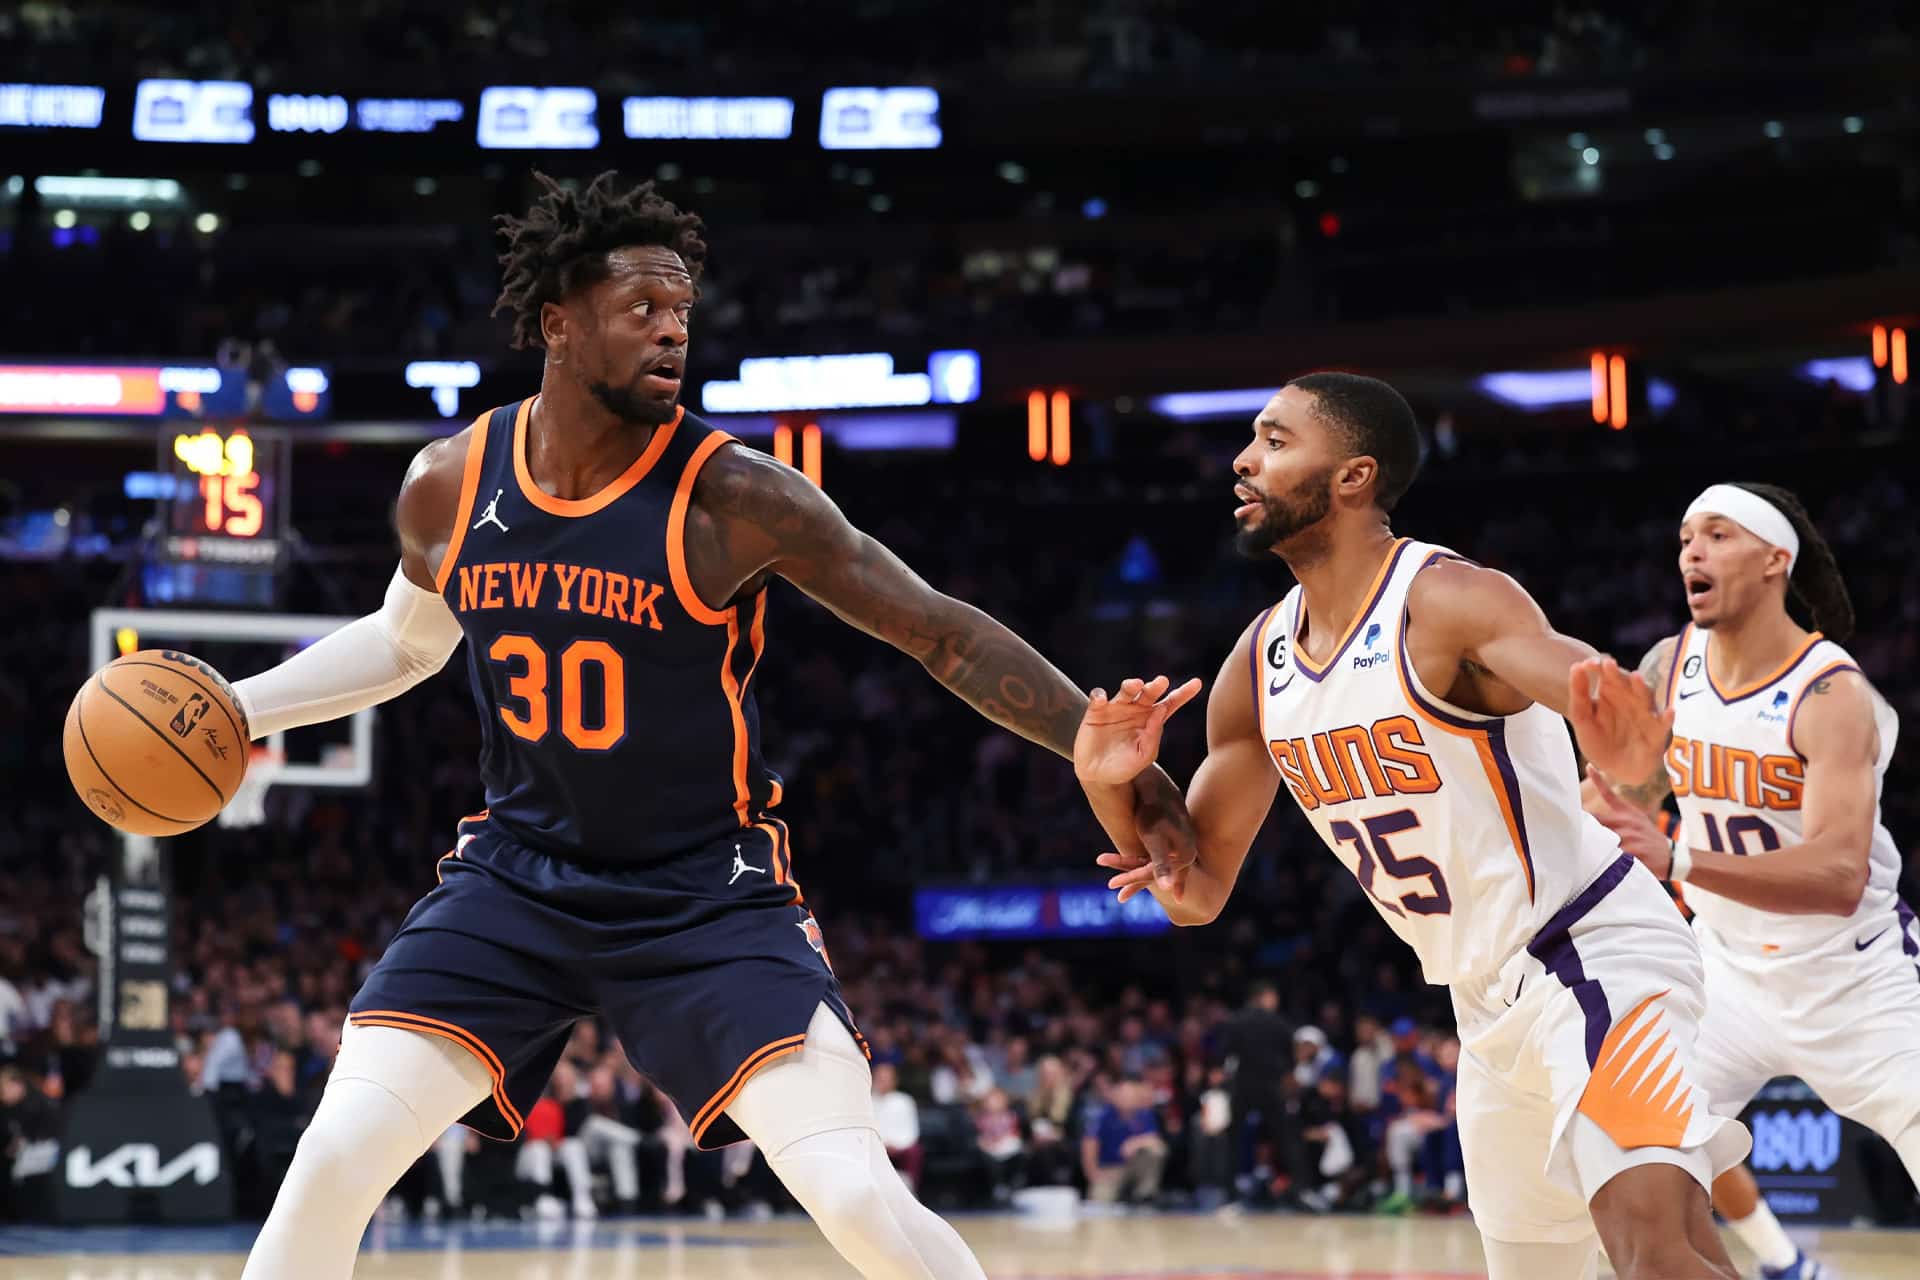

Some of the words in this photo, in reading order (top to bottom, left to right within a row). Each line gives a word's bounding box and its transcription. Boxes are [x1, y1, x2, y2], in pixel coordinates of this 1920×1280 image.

[459, 562, 547, 612] NEW
[553, 563, 665, 631] YORK
[489, 633, 627, 751] 30
[1353, 648, 1390, 670] PayPal
[1269, 714, 1443, 811] SUNS
[1665, 735, 1808, 811] SUNS
[1328, 808, 1452, 919] 25
